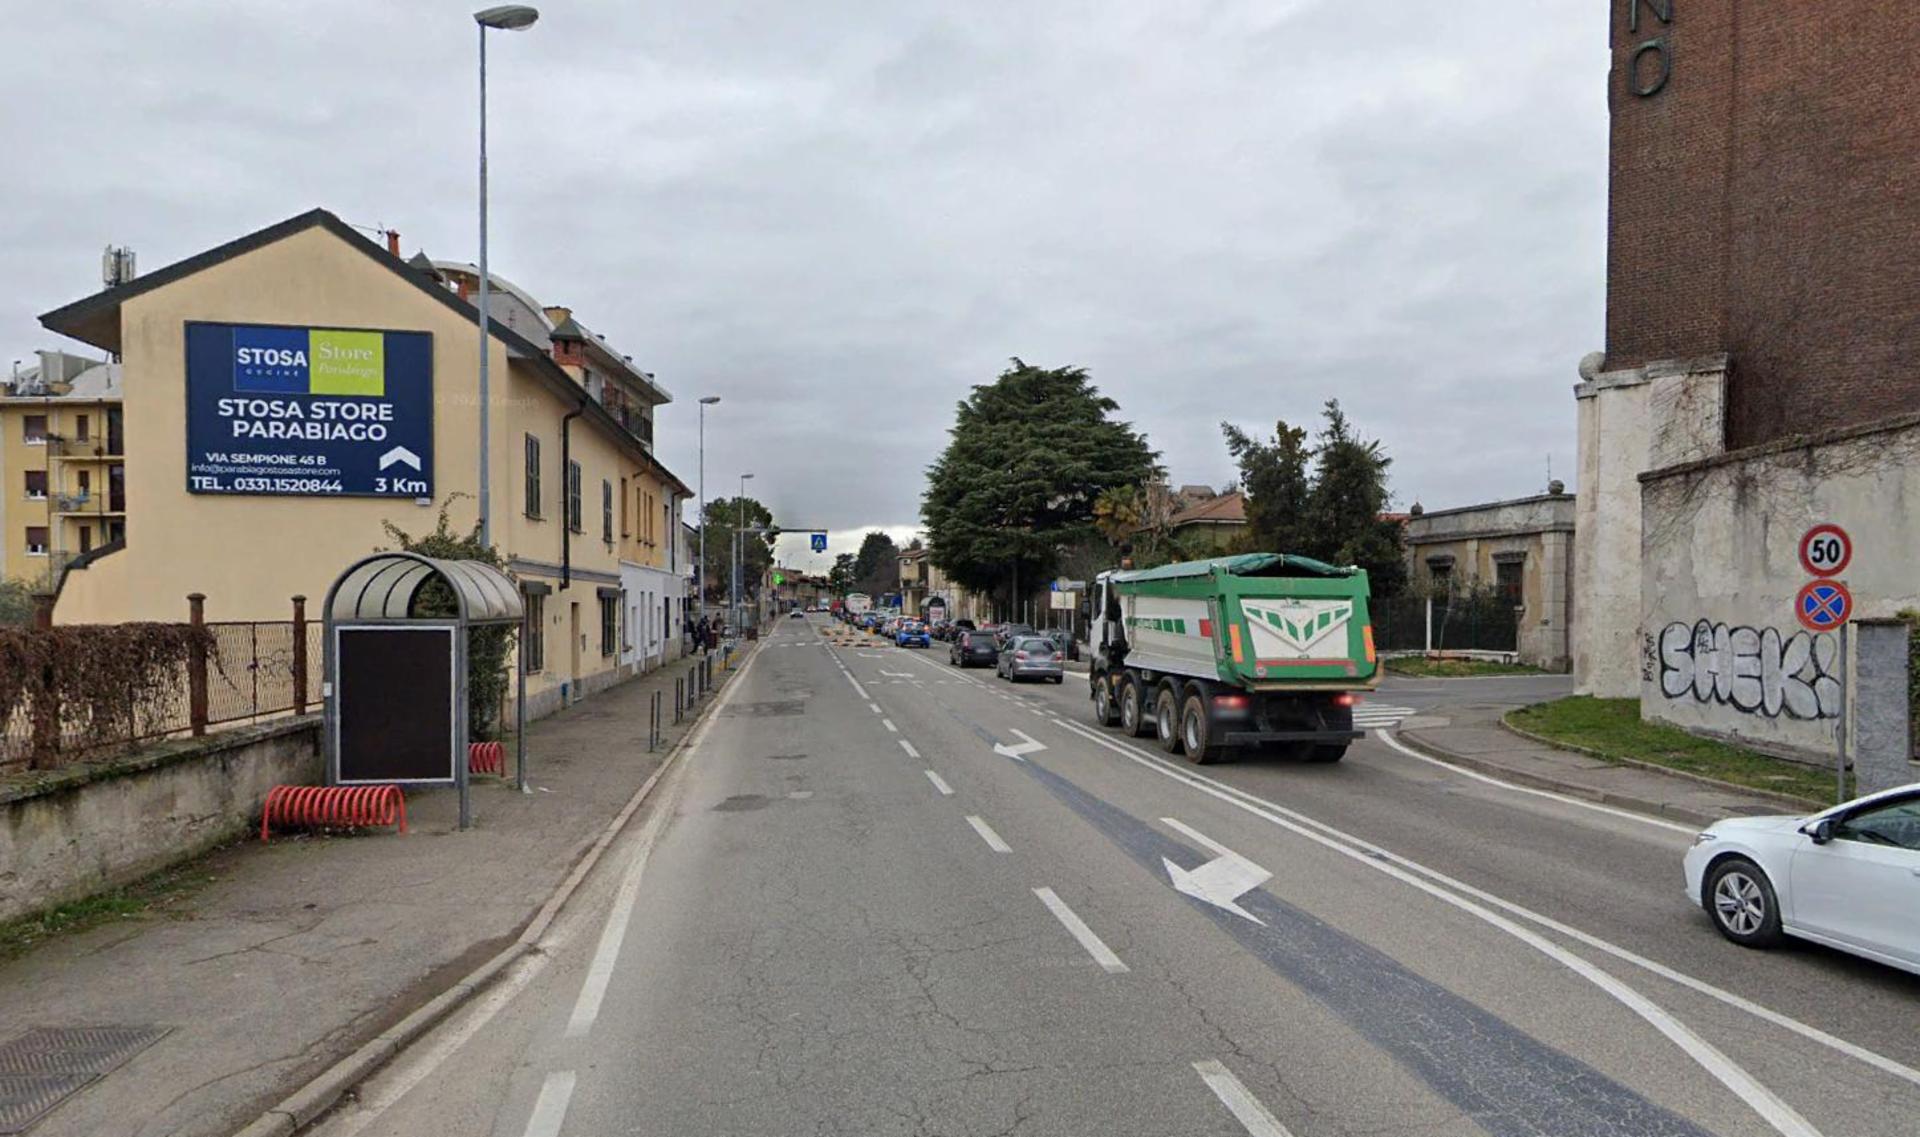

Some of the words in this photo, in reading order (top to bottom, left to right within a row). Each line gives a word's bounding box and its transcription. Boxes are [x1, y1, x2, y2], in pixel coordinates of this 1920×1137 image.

[237, 347, 308, 367] STOSA
[318, 341, 374, 361] Store
[218, 399, 304, 419] STOSA
[310, 402, 394, 421] STORE
[233, 420, 388, 441] PARABIAGO
[206, 452, 229, 463] VIA
[230, 453, 297, 465] SEMPIONE
[299, 455, 315, 465] 45
[317, 456, 327, 466] B
[234, 478, 343, 492] 0331.1520844
[375, 477, 388, 492] 3
[393, 478, 427, 493] Km
[1811, 538, 1841, 564] 50
